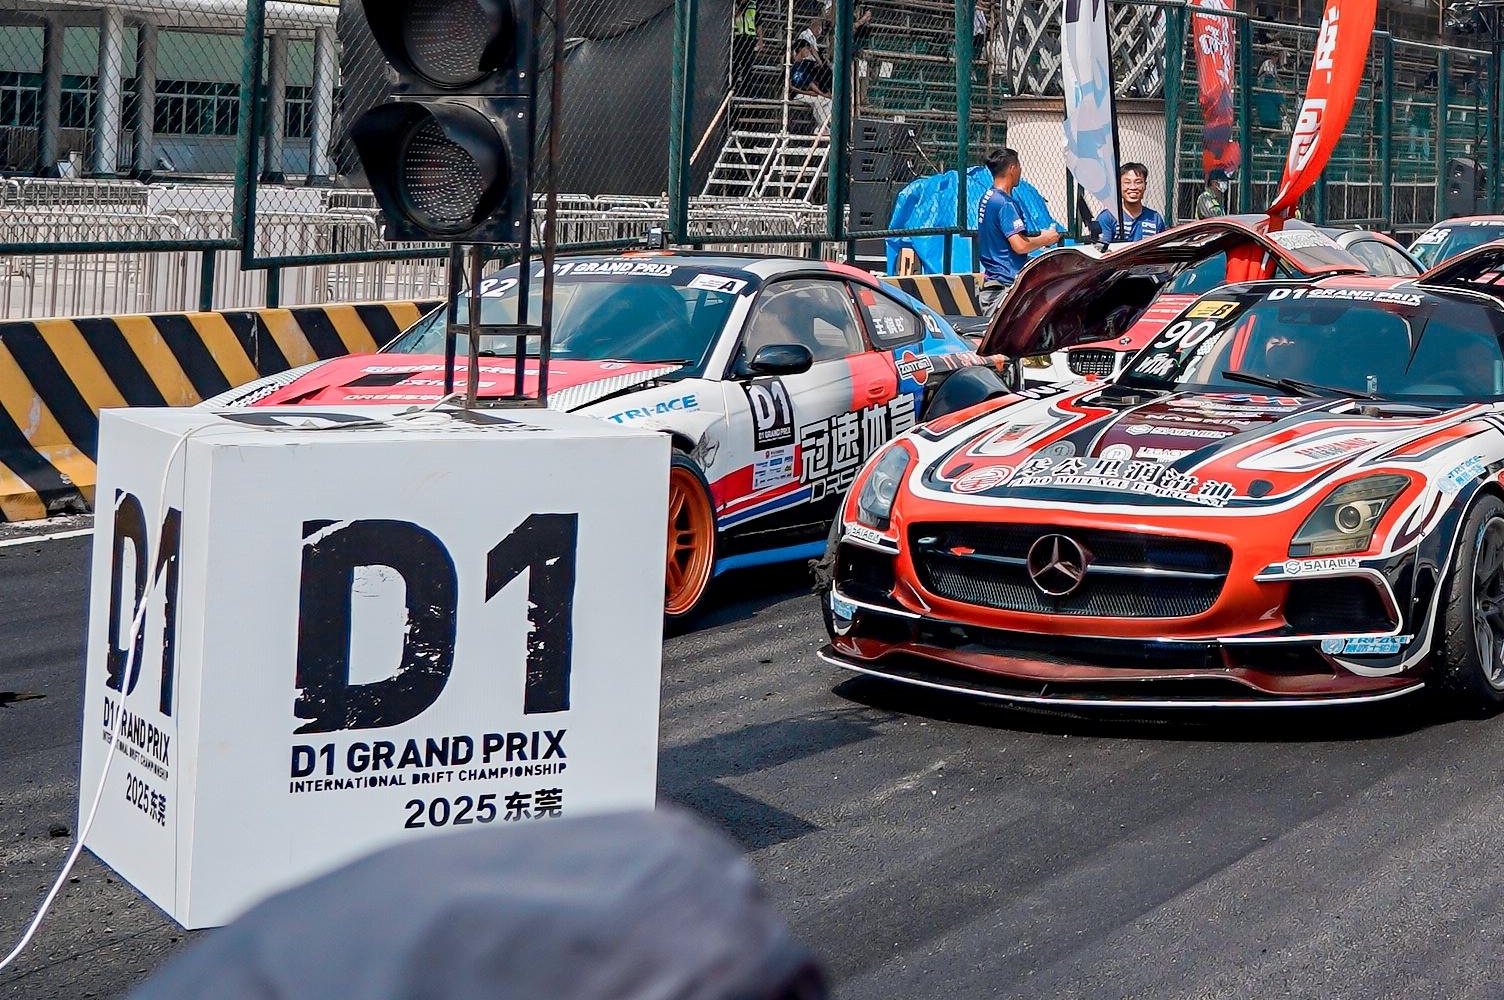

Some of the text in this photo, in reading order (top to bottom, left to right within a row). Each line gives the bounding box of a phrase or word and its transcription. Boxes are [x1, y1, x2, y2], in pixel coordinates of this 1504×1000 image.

[573, 261, 636, 274] GRAND
[634, 262, 679, 276] PRIX
[719, 280, 738, 292] A
[1267, 288, 1308, 301] D1
[1307, 289, 1376, 299] GRAND
[1376, 290, 1425, 303] PRIX
[1214, 302, 1231, 316] B
[1154, 320, 1217, 351] 90
[608, 394, 699, 424] TRI-ACE
[749, 380, 791, 431] D1
[1145, 413, 1252, 426] NASHIN
[800, 392, 916, 484] 冠速体育
[1304, 557, 1358, 571] SATA世达
[106, 488, 183, 716] D1
[293, 512, 580, 735] D1
[102, 696, 115, 731] D1
[147, 723, 171, 767] PRIX
[290, 729, 568, 780] D1 GRAND PRIX
[289, 762, 568, 794] INTERNATIONAL DRIFT CHAMPIONSHIP
